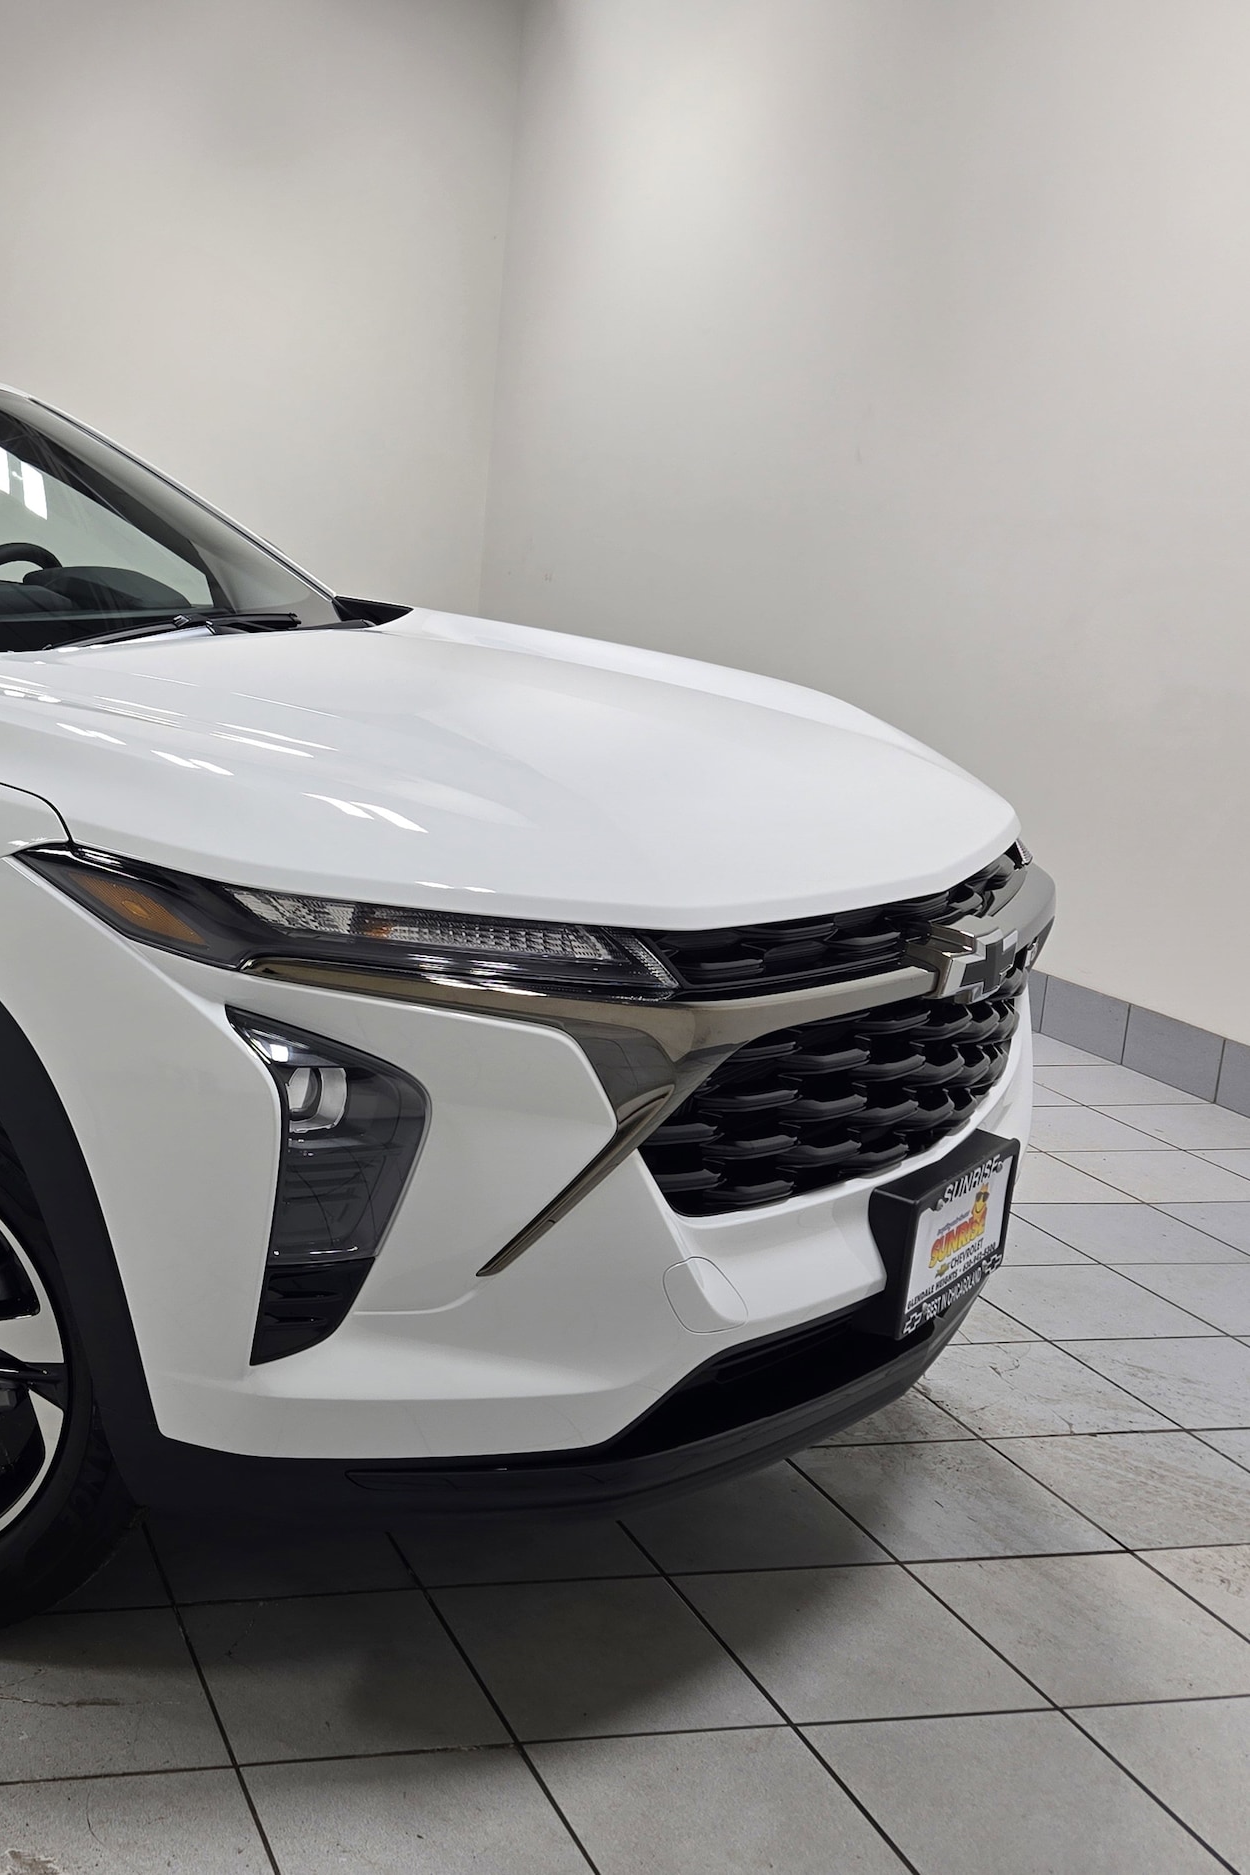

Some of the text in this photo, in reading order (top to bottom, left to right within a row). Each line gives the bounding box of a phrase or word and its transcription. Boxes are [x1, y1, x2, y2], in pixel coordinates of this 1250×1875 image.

[943, 1154, 1001, 1203] SUNRISE
[928, 1217, 986, 1268] SUNRISE
[950, 1238, 984, 1269] CHEVROLET
[907, 1284, 935, 1310] GLENDALE
